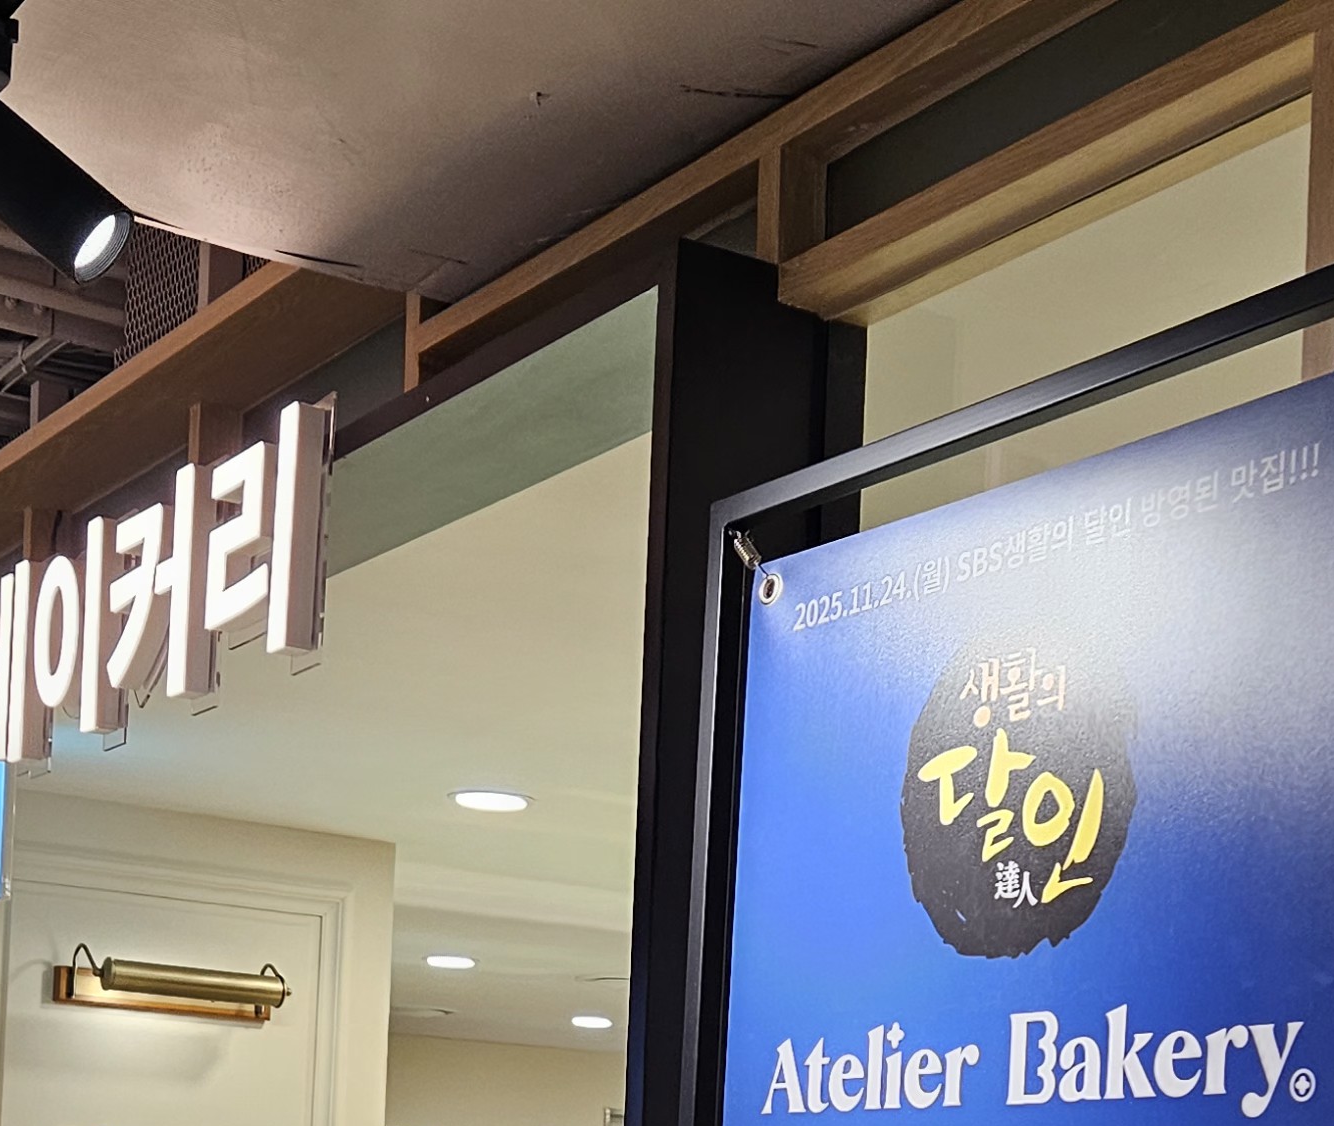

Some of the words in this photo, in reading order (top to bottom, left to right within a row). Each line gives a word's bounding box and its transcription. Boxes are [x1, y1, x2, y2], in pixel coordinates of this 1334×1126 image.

[792, 558, 953, 633] 2025.11.24.(월)
[956, 516, 1075, 583] SBS생활의
[1083, 497, 1135, 546] 달인
[1140, 470, 1220, 528] 방영된
[1229, 443, 1321, 502] 맛집!!!
[961, 645, 1067, 727] 생활의
[917, 728, 1106, 905] 달인
[993, 861, 1038, 910] 達人
[760, 1021, 980, 1115] Atelier
[1006, 1003, 1306, 1119] Bakery
